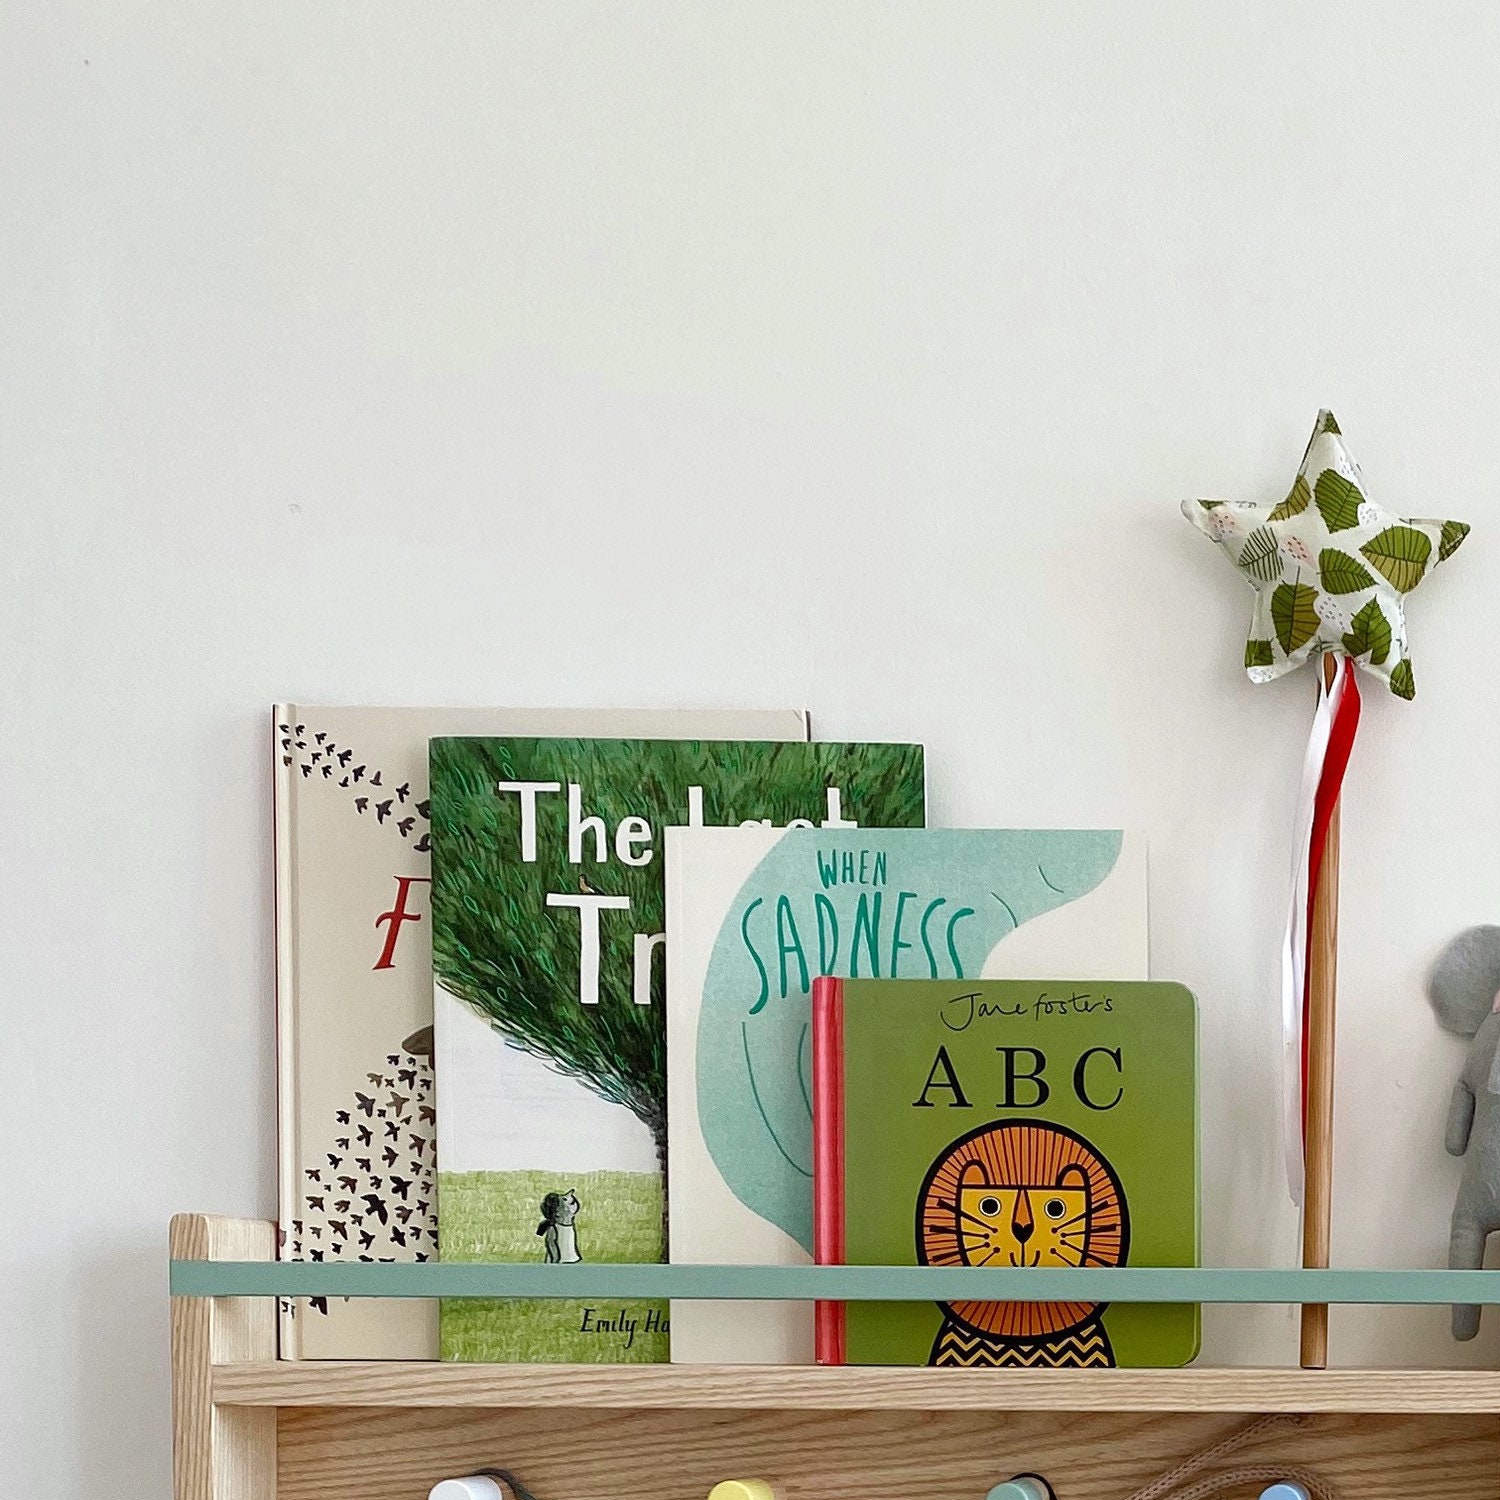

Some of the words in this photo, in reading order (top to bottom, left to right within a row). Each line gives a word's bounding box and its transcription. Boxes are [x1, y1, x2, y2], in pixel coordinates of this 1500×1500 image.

[498, 781, 653, 867] The
[817, 848, 887, 889] WHEN
[940, 992, 1028, 1031] Jane
[580, 1308, 638, 1350] Emily
